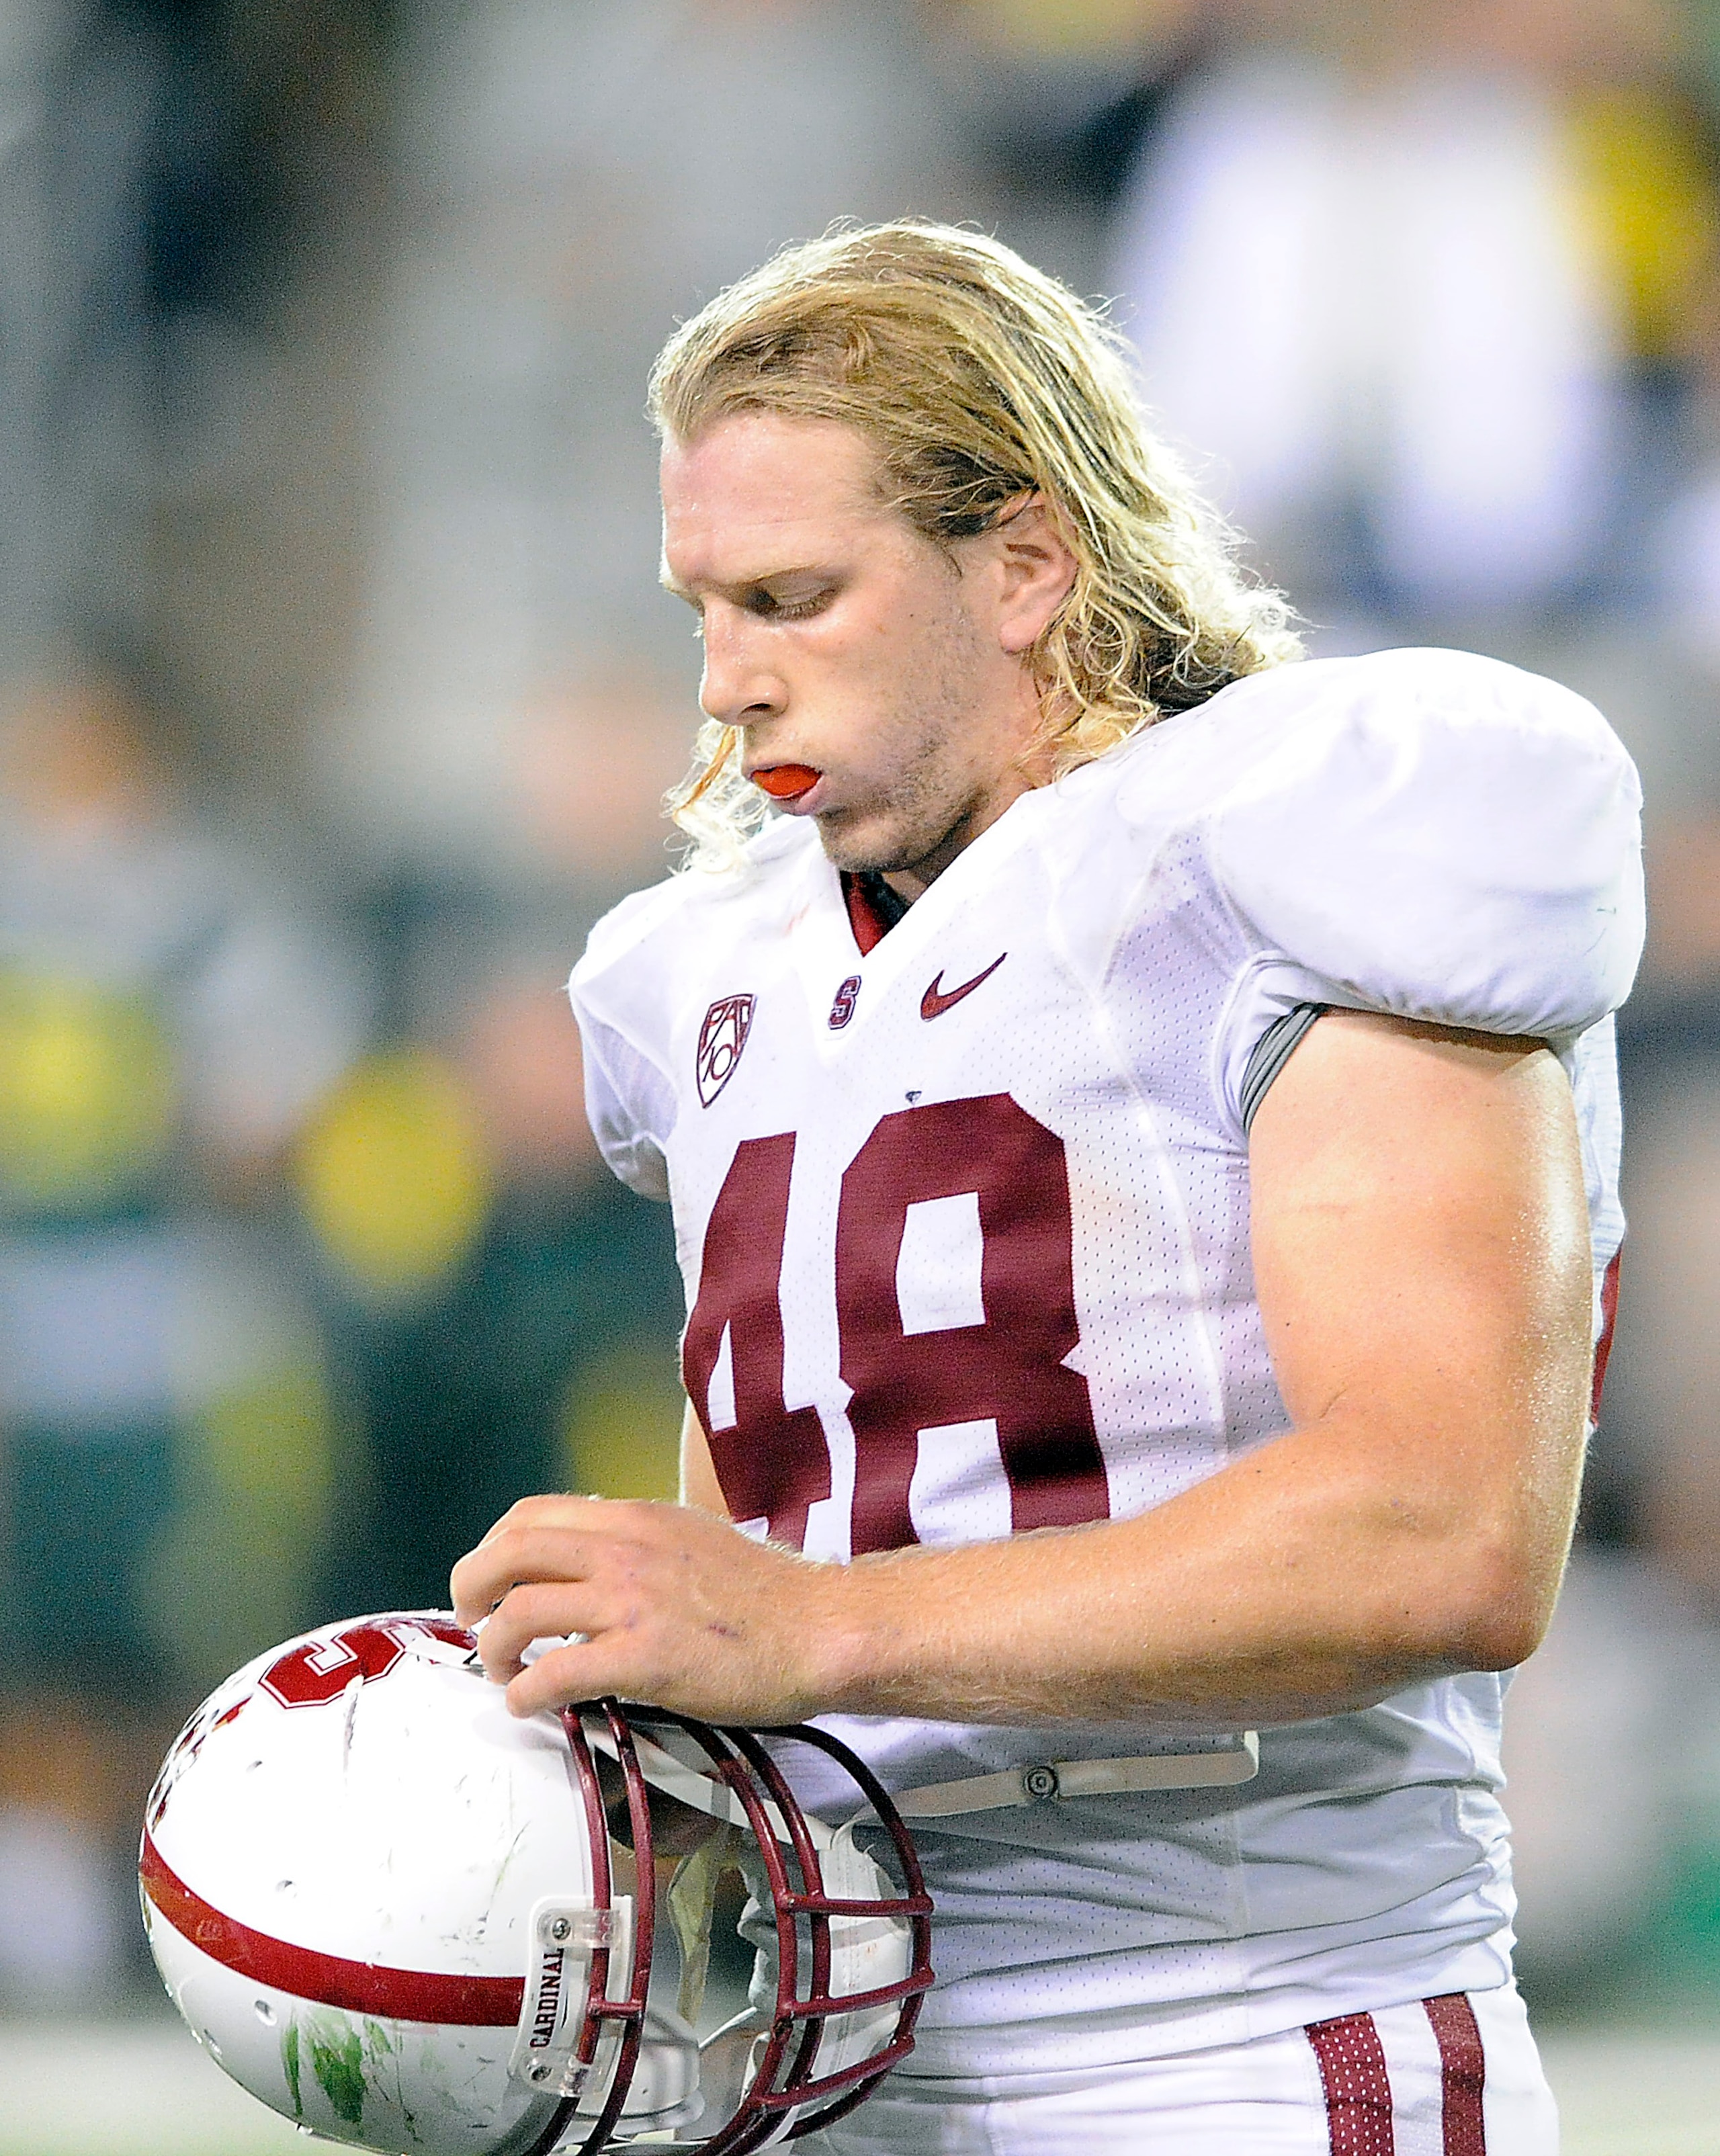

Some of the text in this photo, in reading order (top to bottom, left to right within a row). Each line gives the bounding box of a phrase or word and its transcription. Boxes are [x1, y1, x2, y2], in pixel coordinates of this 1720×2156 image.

[828, 975, 861, 1029] S
[682, 1092, 1111, 1555] 48
[529, 1947, 564, 2049] CARDINAL
